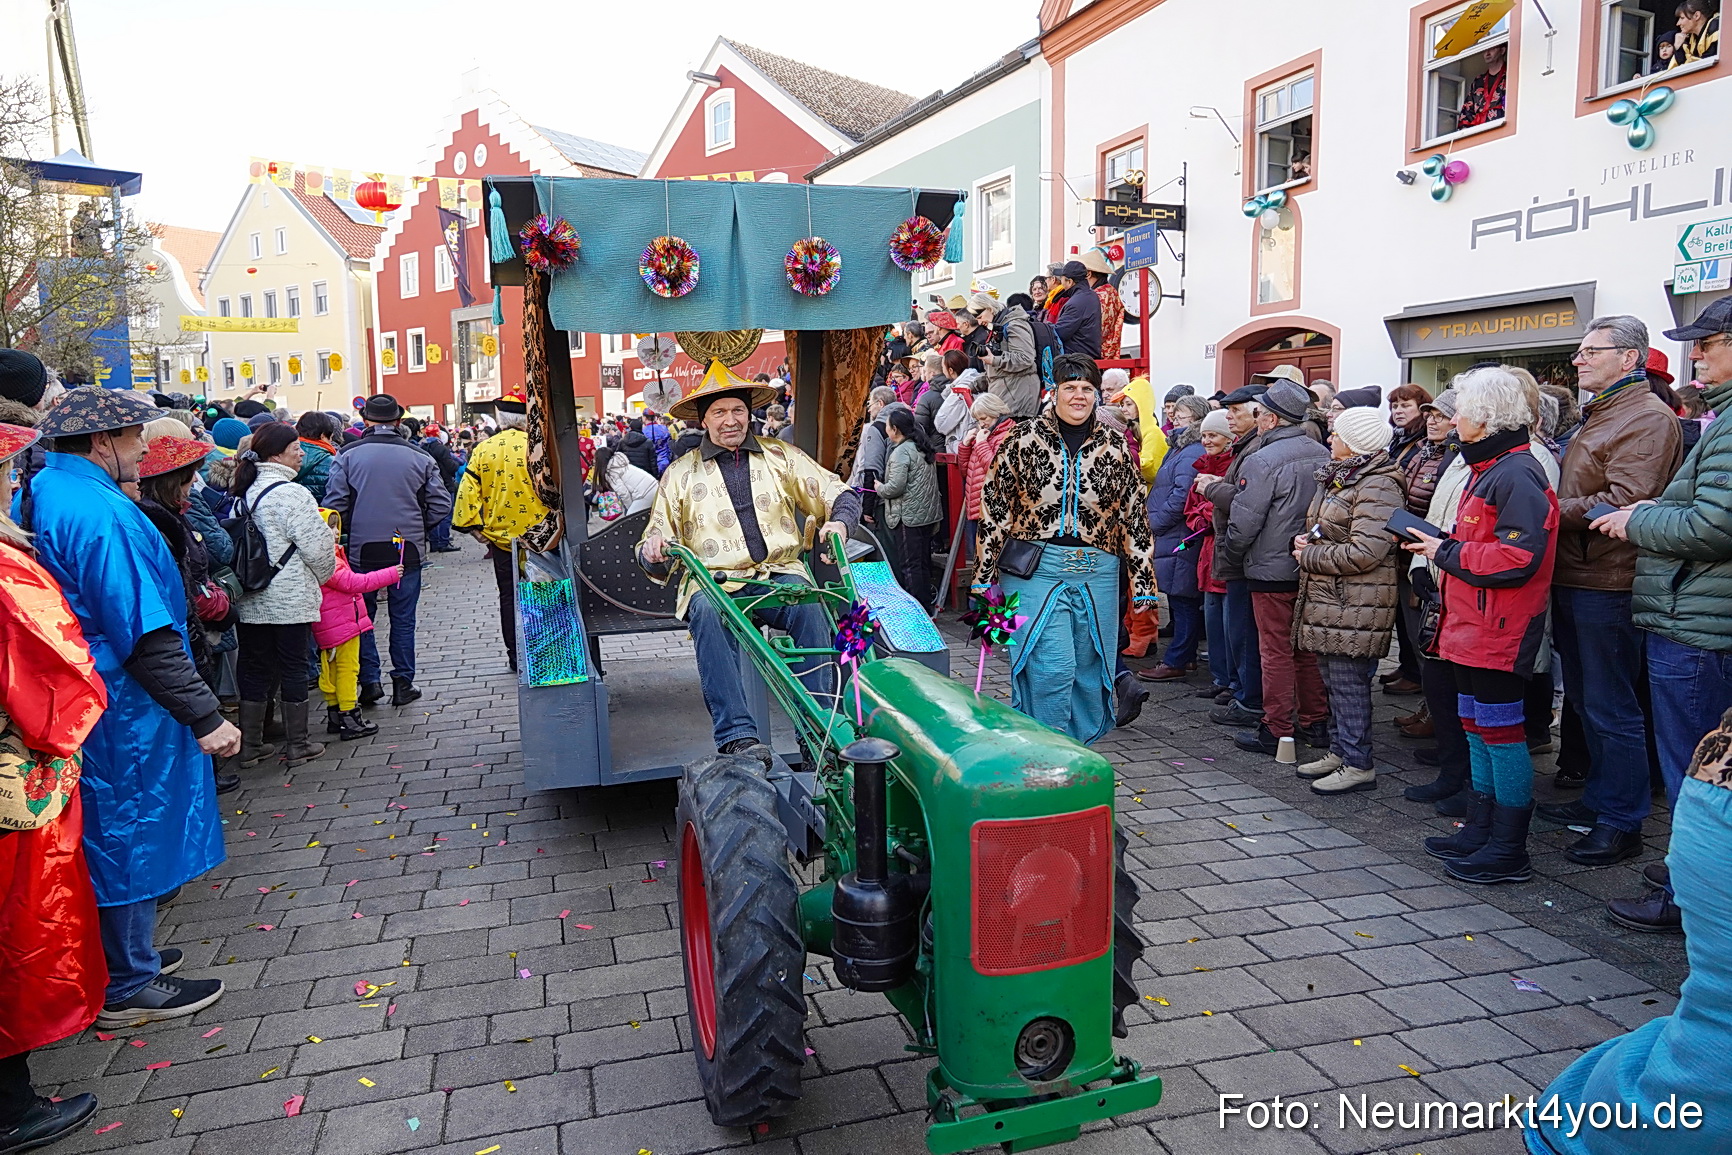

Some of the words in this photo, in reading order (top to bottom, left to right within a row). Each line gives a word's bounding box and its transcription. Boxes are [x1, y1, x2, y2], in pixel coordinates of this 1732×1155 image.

[1601, 149, 1695, 185] JUWELIER
[1105, 205, 1177, 220] RÖHLICH
[1470, 167, 1732, 250] RÖHLI
[1680, 274, 1694, 284] NA
[1439, 310, 1575, 338] TRAURINGE
[602, 366, 620, 376] CAFÉ
